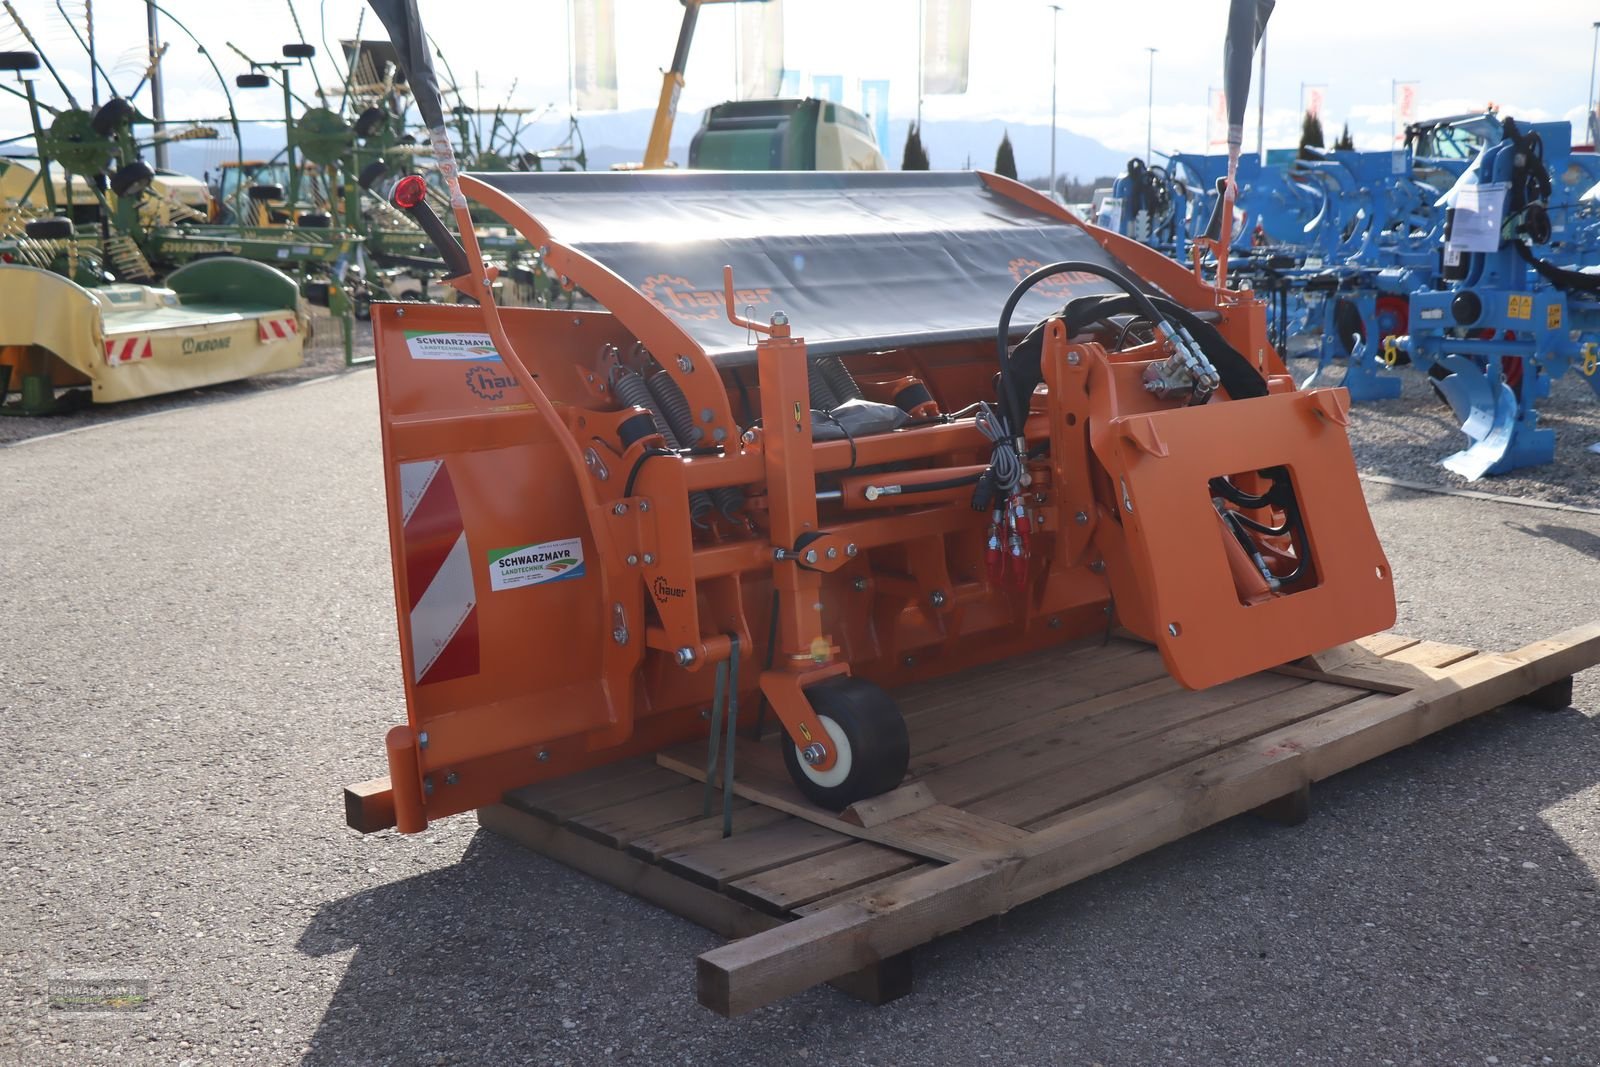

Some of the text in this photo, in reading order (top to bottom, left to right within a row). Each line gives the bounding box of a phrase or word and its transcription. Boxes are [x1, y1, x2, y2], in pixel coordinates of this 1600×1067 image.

[195, 336, 232, 353] KRONE
[415, 337, 492, 347] SCHWARZMAYR
[498, 549, 571, 569] SCHWARZMAYR
[501, 564, 544, 577] LANDTECHNIK
[659, 582, 687, 598] hauer
